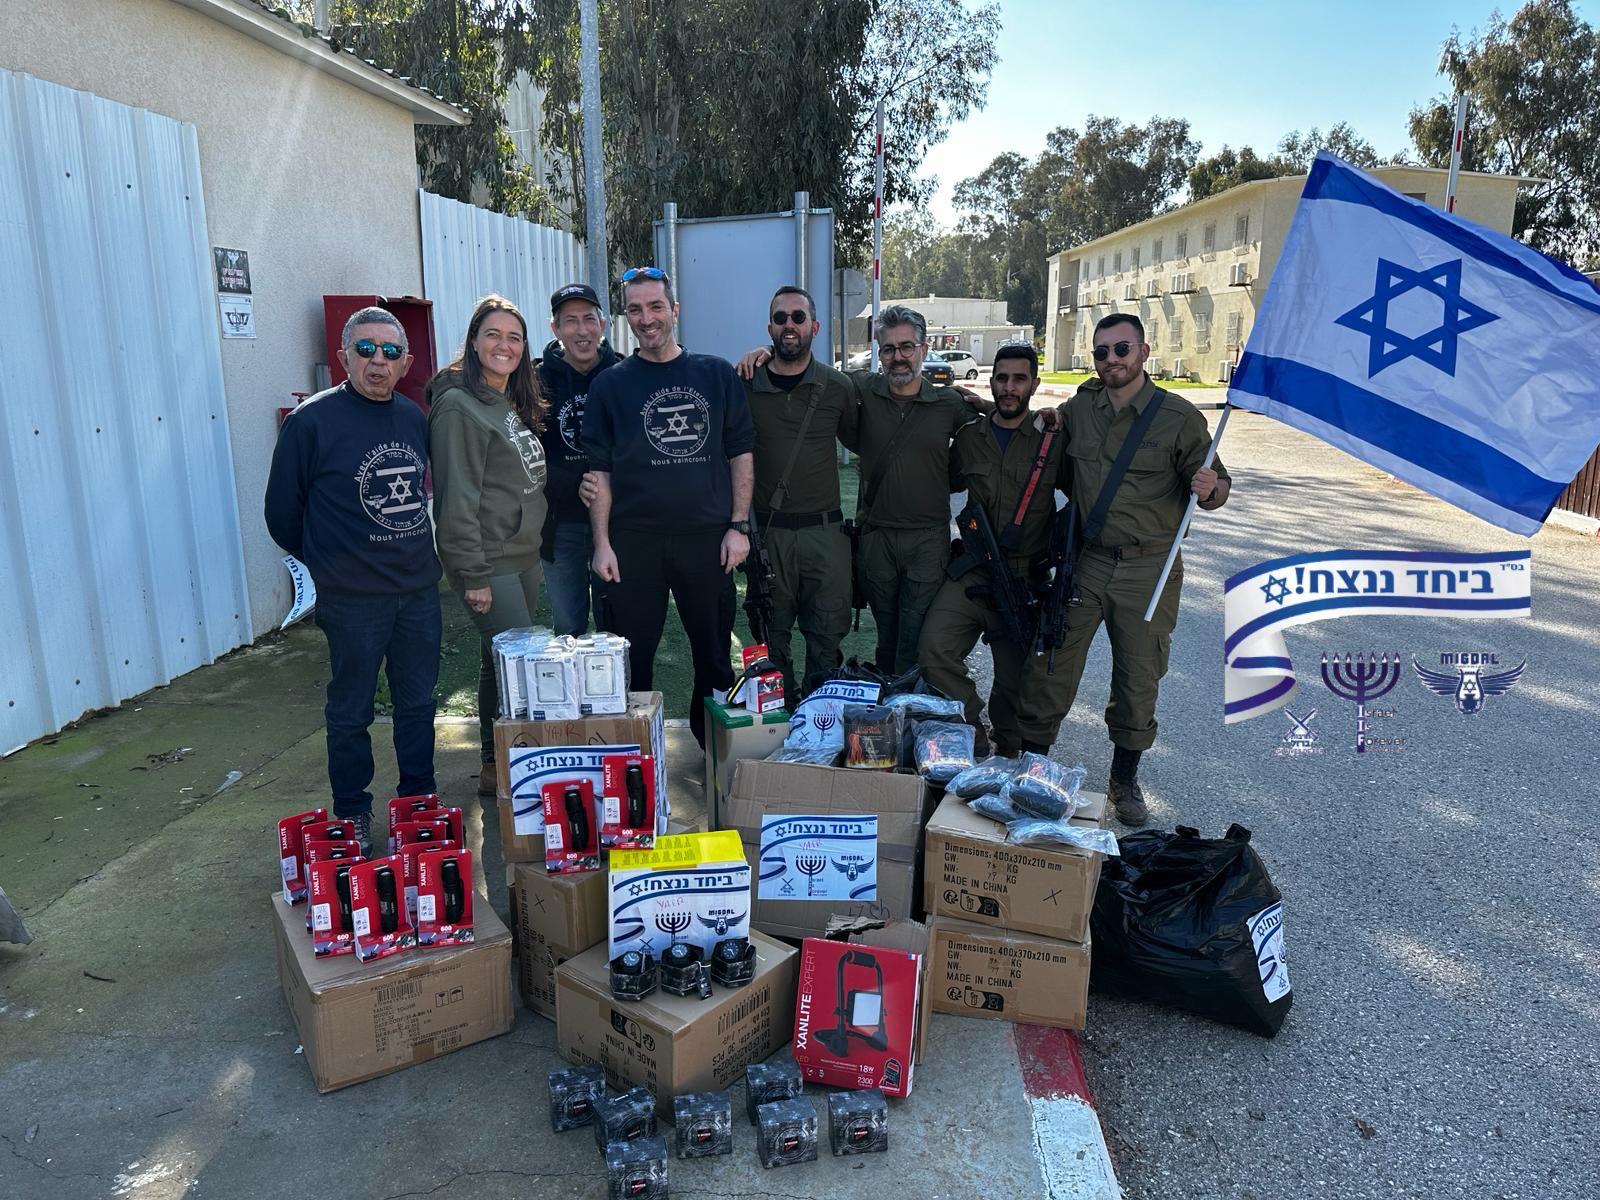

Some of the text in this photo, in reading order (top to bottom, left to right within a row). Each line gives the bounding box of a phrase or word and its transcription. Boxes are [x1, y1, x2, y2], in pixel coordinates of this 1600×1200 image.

[354, 460, 368, 483] Avec
[365, 442, 388, 460] l'aide
[391, 440, 400, 448] de
[369, 534, 393, 542] Nous
[540, 755, 584, 768] ננצח!
[604, 764, 612, 789] XANLITE
[543, 791, 552, 816] XANLITE
[788, 822, 863, 834] ביחד ננצח!
[280, 826, 288, 850] XANLITE
[566, 852, 578, 860] 600
[944, 842, 1063, 872] Dimensions: 400x370x210 mm
[944, 852, 960, 863] GW:
[1006, 863, 1019, 874] KG
[944, 863, 1017, 885] NW: KG
[312, 870, 321, 896] XANLITE
[351, 875, 360, 901] XANLITE
[644, 875, 734, 891] ביחד ננצח!
[943, 873, 1009, 894] MADE IN CHINA
[708, 908, 736, 917] MIGDAL
[337, 933, 350, 941] 600
[382, 933, 394, 942] 600
[441, 925, 453, 933] 600
[947, 950, 963, 961] GW:
[1010, 958, 1022, 969] KG
[948, 940, 1067, 964] Dimensions: 400x370x210 mm
[946, 961, 1022, 979] NW: KG
[946, 972, 1013, 989] MADE IN CHINA
[600, 1042, 609, 1053] KG
[605, 1033, 657, 1071] MADE IN CHINA
[728, 1042, 736, 1054] 30
[712, 1050, 725, 1066] PCS
[857, 1076, 874, 1085] 2300
